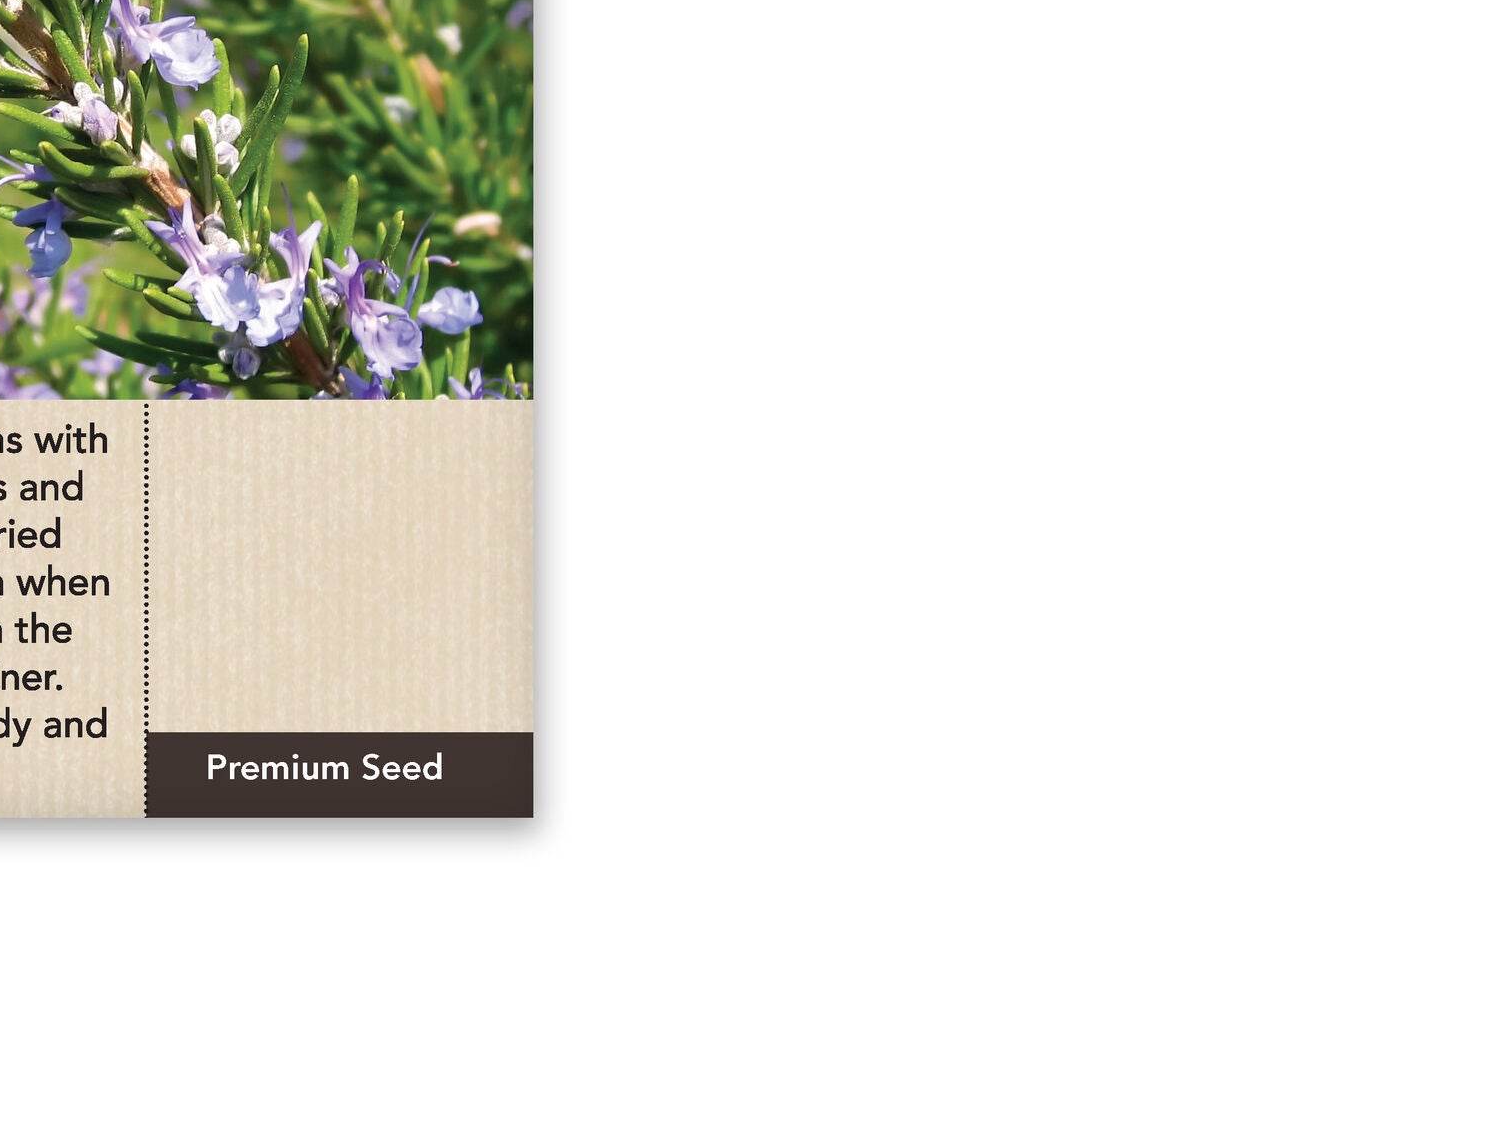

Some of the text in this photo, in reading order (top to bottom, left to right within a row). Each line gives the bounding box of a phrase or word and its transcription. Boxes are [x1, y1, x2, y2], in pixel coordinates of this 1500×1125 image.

[34, 423, 107, 454] with
[20, 470, 82, 501] and
[16, 564, 109, 595] when
[15, 612, 72, 643] the
[44, 707, 106, 738] and
[208, 752, 442, 780] Premium Seed
